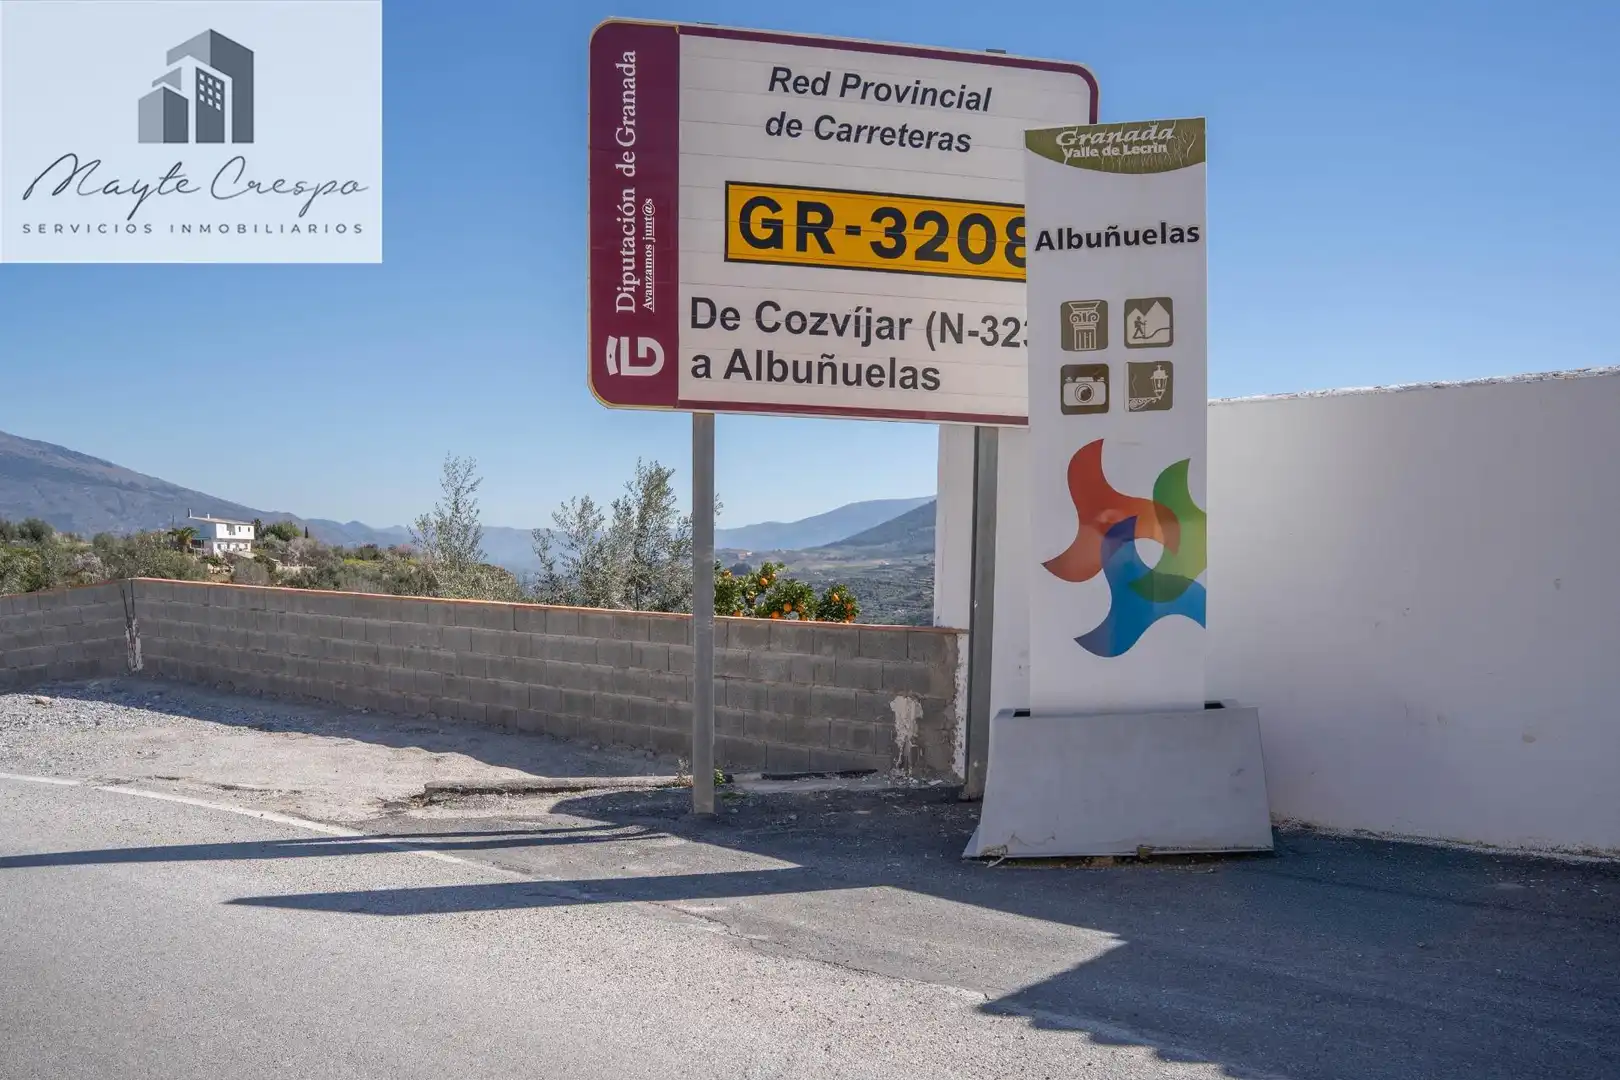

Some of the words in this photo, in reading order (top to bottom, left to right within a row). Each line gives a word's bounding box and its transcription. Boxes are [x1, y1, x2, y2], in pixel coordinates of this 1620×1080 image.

[615, 50, 636, 147] Granada
[768, 67, 830, 97] Red
[840, 73, 992, 112] Provincial
[765, 112, 804, 139] de
[814, 115, 972, 153] Carreteras
[1056, 121, 1175, 147] Granada
[1063, 145, 1099, 159] Valle
[1102, 143, 1120, 156] de
[616, 150, 636, 178] de
[642, 198, 656, 242] junt@s
[1035, 222, 1200, 252] Albuñuelas
[616, 187, 641, 313] Diputación
[642, 243, 655, 312] Avanzamos
[691, 296, 742, 331] De
[755, 302, 913, 347] Cozvíjar
[926, 311, 1028, 351] (N-32
[691, 354, 713, 379] a
[723, 350, 941, 391] Albuñuelas
